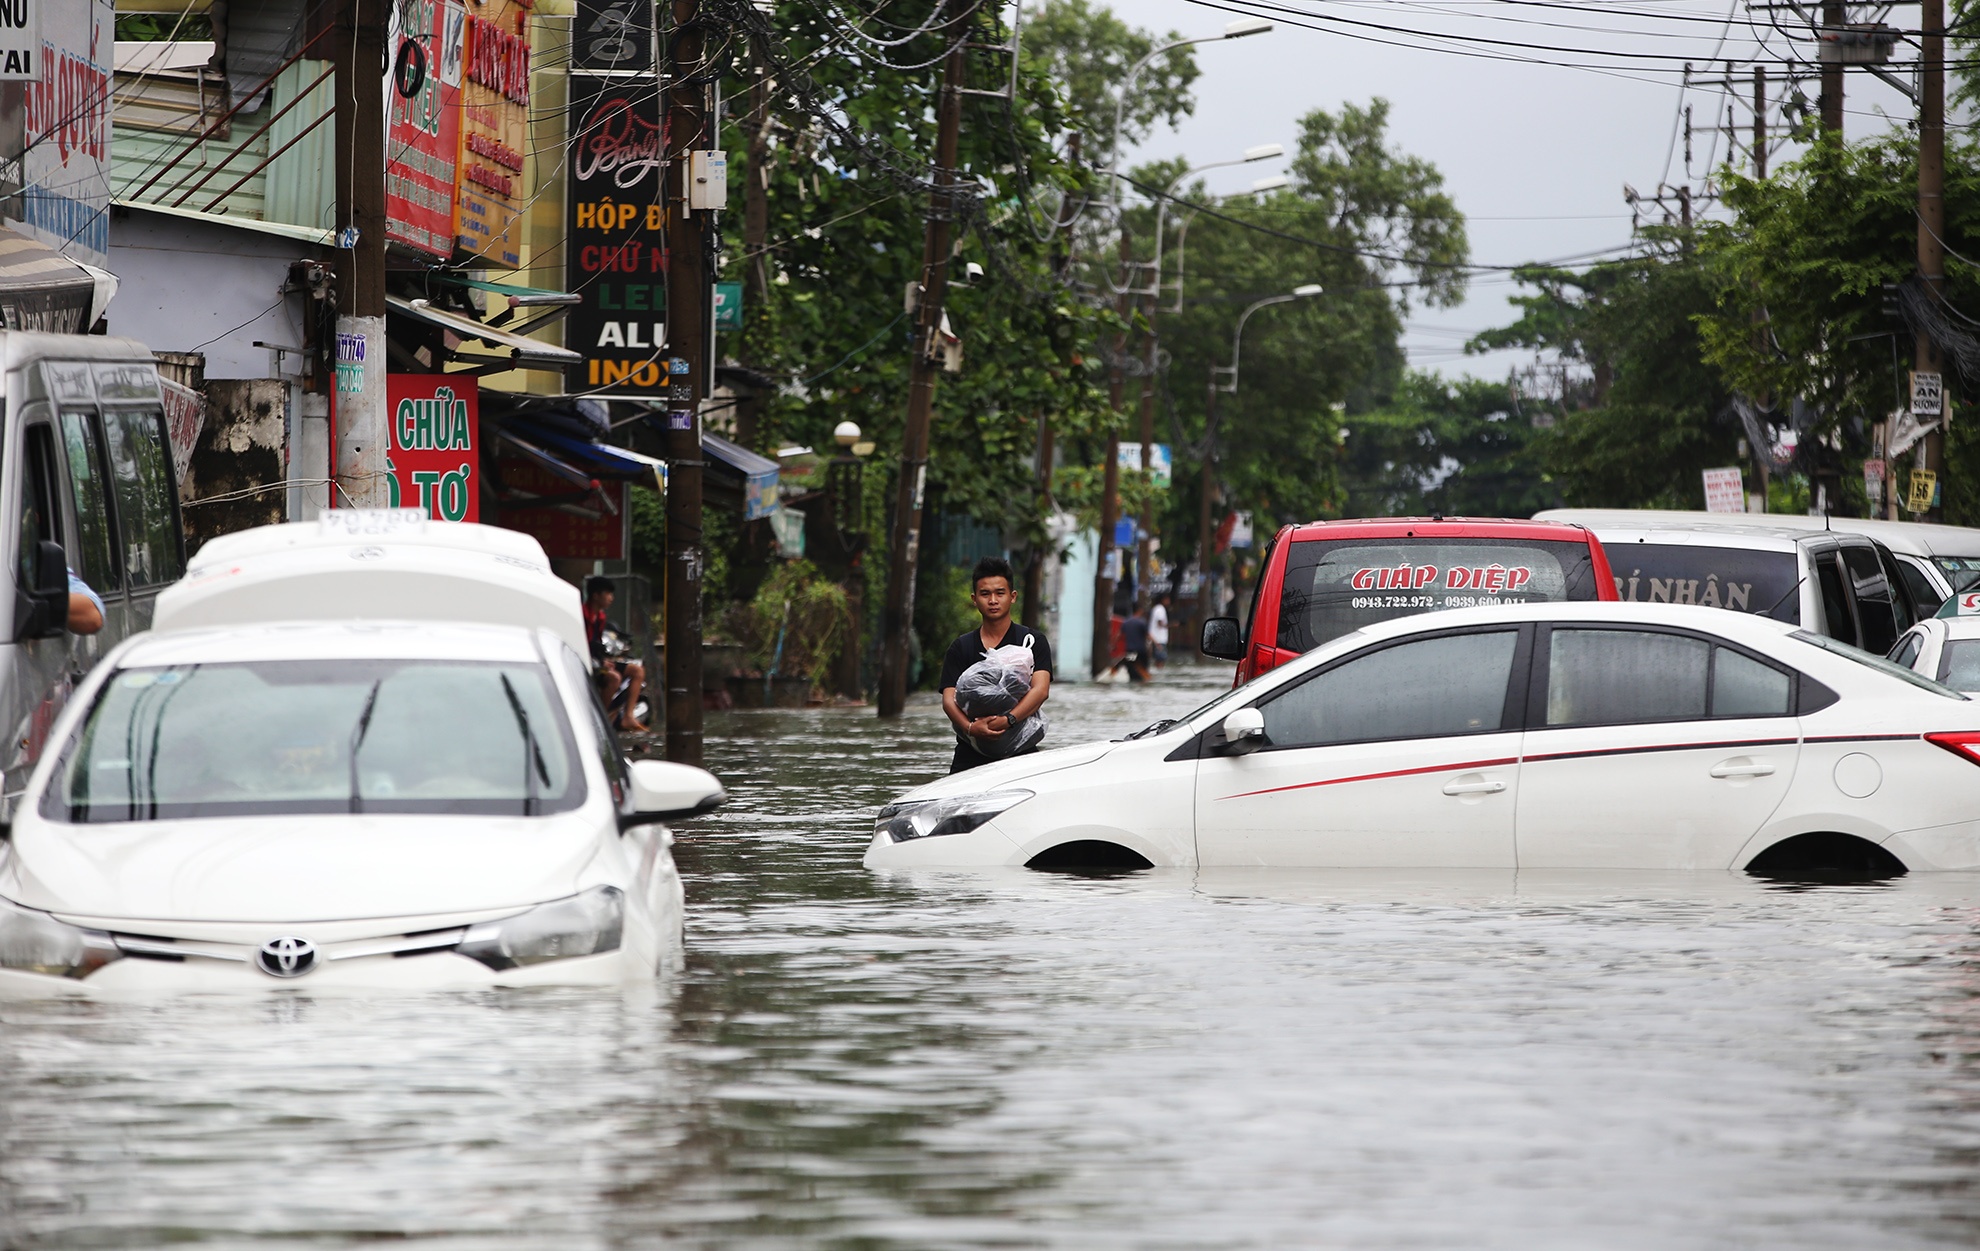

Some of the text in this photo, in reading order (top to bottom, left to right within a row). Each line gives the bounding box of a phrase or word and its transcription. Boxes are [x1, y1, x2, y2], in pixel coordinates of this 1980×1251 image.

[0, 50, 31, 73] AI
[577, 196, 670, 234] HỘP Đ
[580, 240, 670, 273] CHỮ N
[1916, 387, 1939, 399] AN
[396, 386, 472, 451] CHỮA
[411, 462, 471, 523] TƠ
[1351, 562, 1531, 594] GIÁP DIỆP
[1648, 573, 1752, 611] NHÂN
